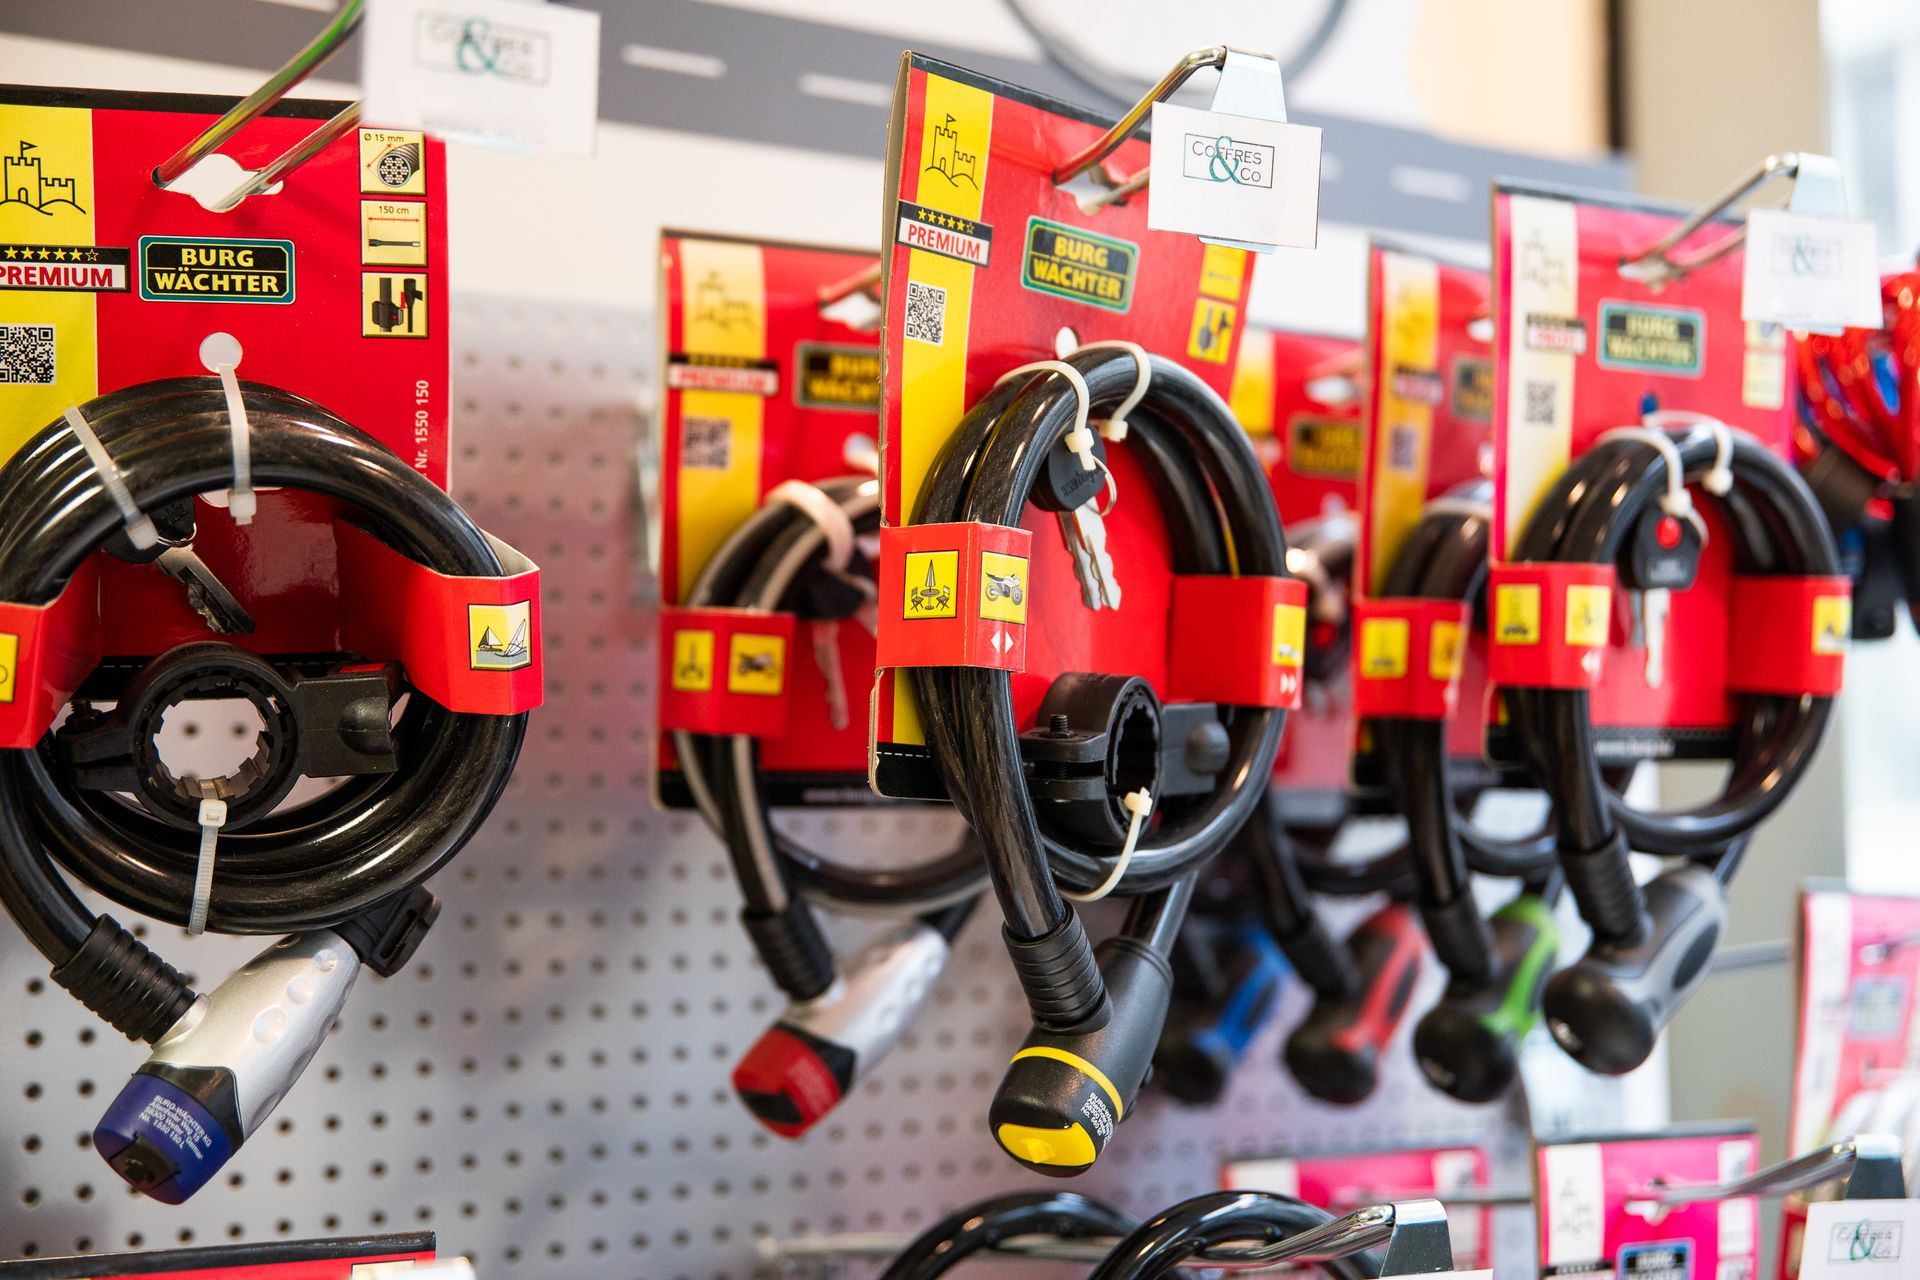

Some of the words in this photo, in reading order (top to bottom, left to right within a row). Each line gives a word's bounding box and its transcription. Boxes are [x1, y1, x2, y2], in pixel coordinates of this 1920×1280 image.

[375, 134, 385, 142] 15
[1209, 136, 1244, 185] &
[379, 206, 394, 214] 150
[908, 223, 981, 260] PREMIUM
[1054, 236, 1109, 268] BURG
[181, 248, 254, 267] BURG
[154, 267, 279, 293] WÄCHTER
[1033, 256, 1121, 299] WÄCHTER
[416, 380, 429, 405] 150
[415, 410, 429, 444] 1550
[415, 449, 428, 469] Nr.
